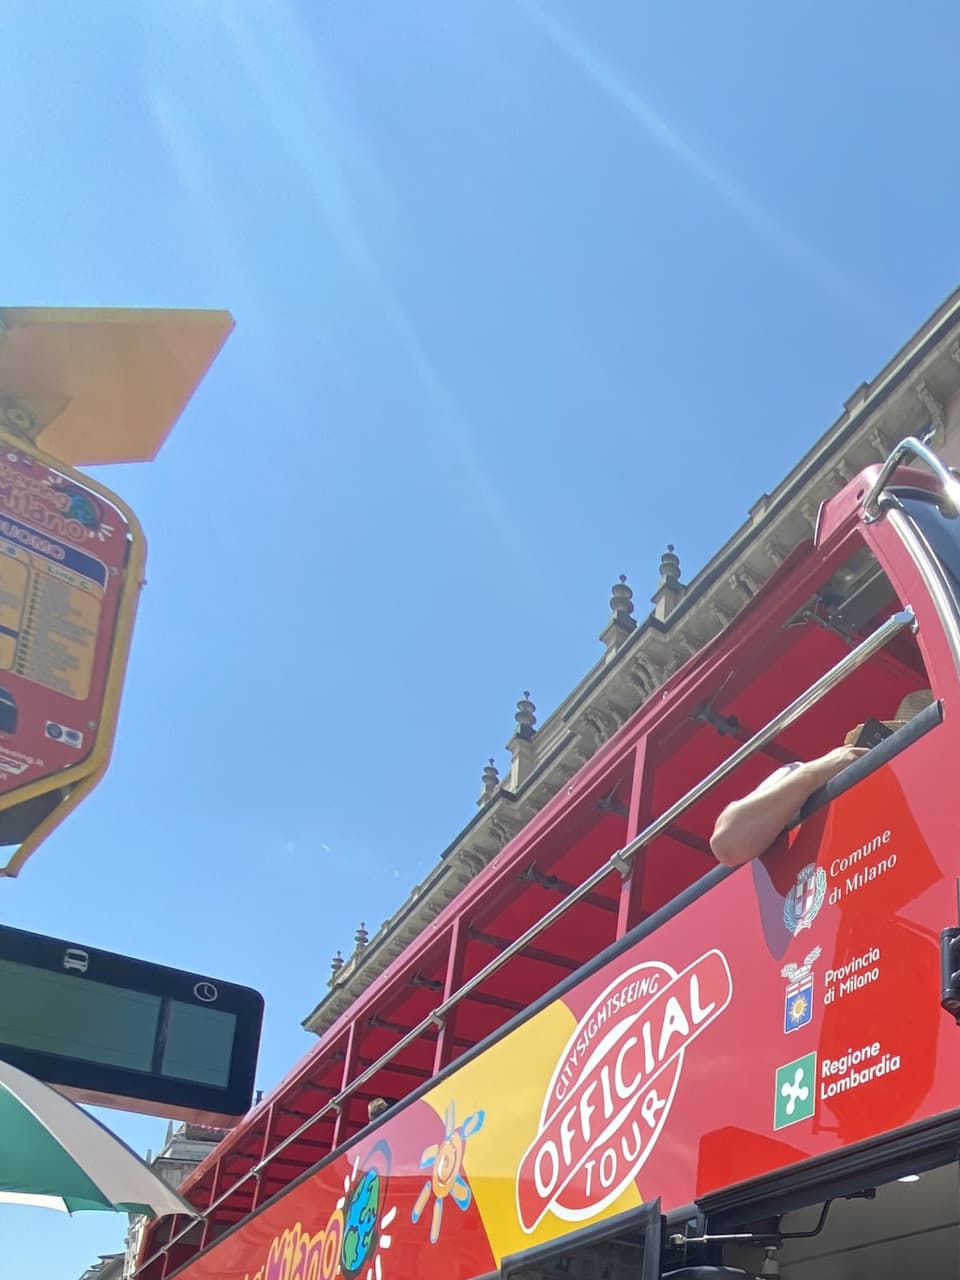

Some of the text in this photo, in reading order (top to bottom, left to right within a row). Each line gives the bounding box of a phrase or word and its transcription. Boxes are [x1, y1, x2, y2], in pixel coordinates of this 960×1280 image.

[0, 520, 65, 561] UOMO
[830, 828, 892, 878] Comune
[828, 852, 897, 906] di Milano
[823, 966, 880, 1006] di Milano
[824, 947, 881, 987] Provincia
[555, 972, 660, 1101] CITYSIGHTSEEING
[821, 1041, 881, 1078] Regione
[534, 973, 716, 1198] OFFICIAL
[820, 1055, 901, 1101] Lombardia
[584, 1088, 666, 1198] TOUR
